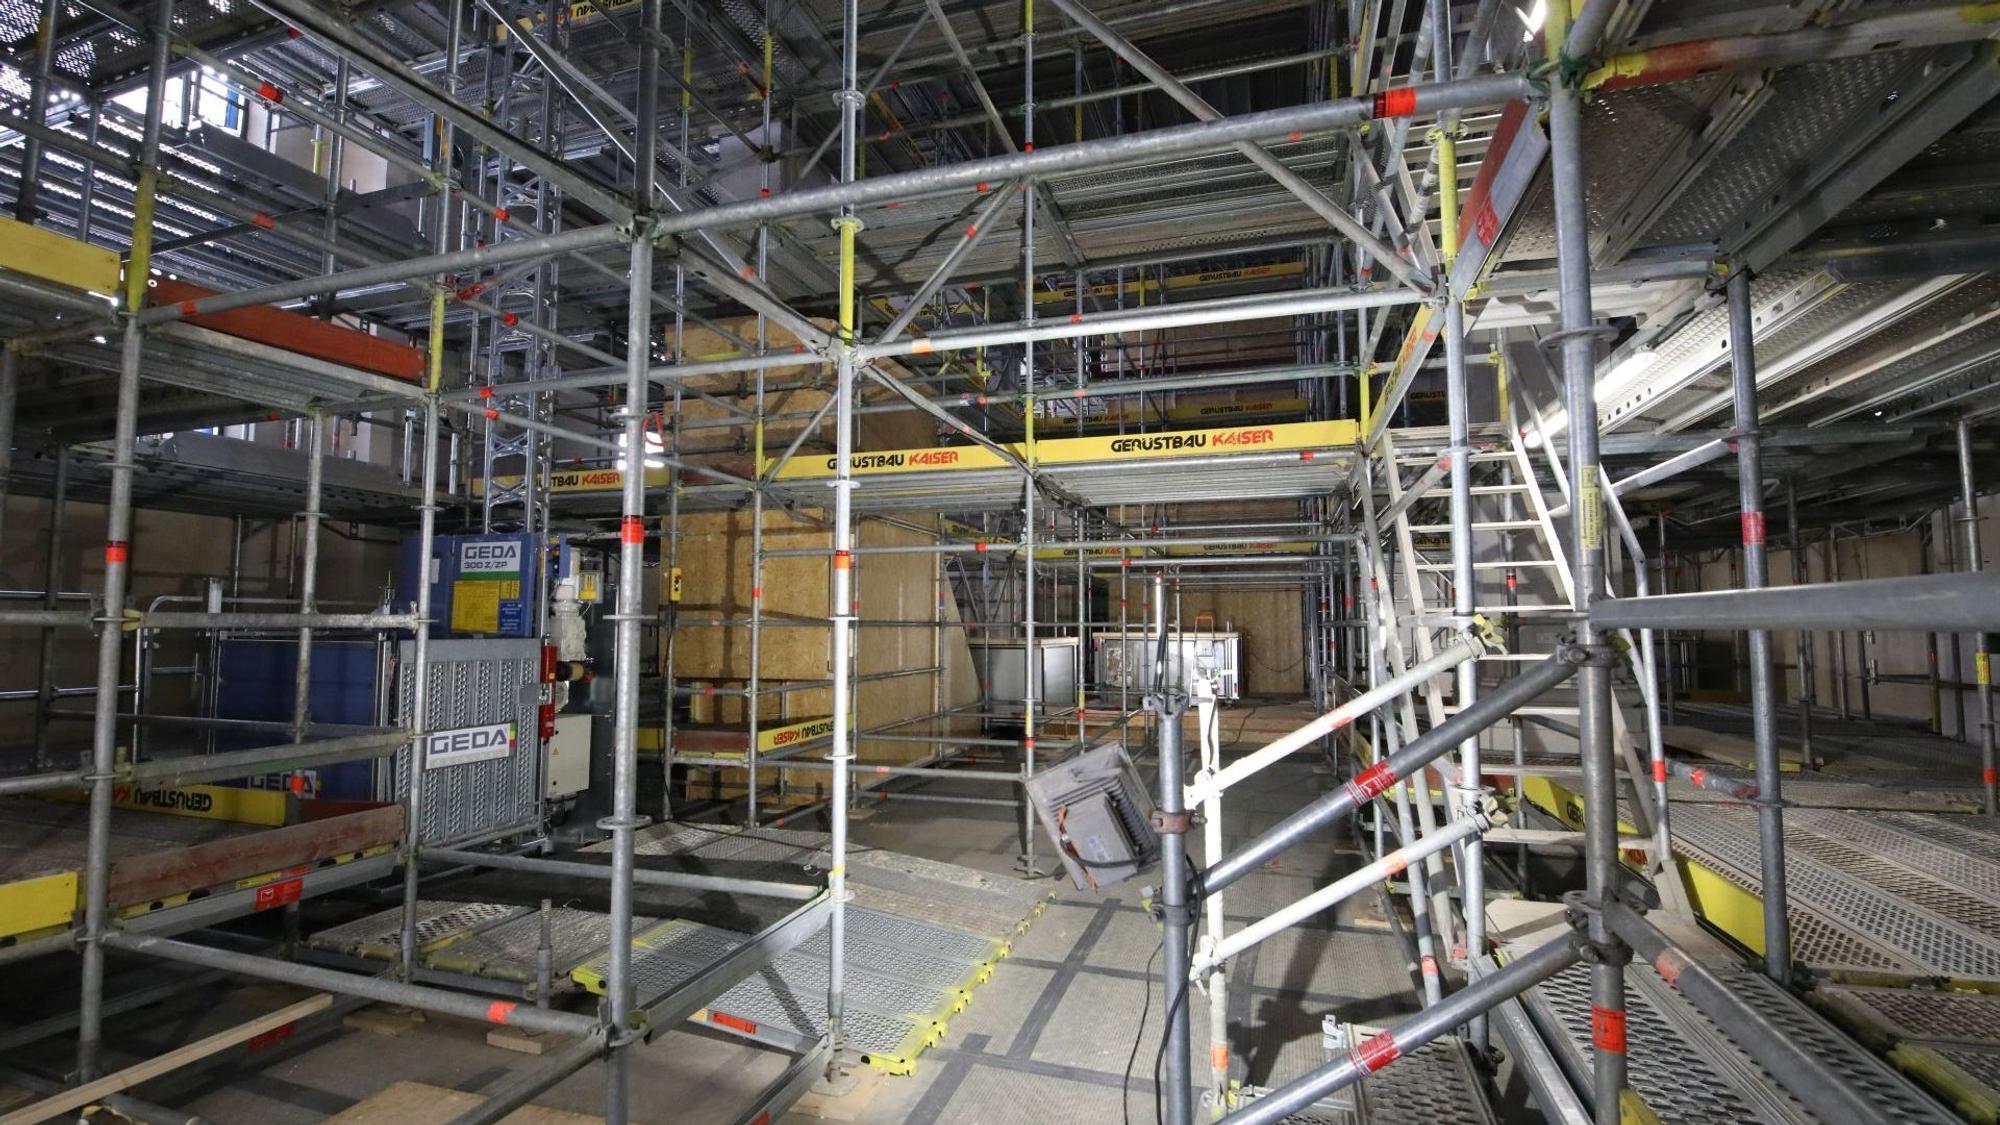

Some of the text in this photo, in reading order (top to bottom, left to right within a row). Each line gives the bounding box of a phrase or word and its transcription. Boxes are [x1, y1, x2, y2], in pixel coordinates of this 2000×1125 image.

[1212, 429, 1274, 447] KAISER
[909, 451, 958, 466] KAISER
[581, 472, 621, 485] KAISER
[464, 545, 516, 559] GEDA
[463, 561, 483, 569] 300
[430, 729, 507, 755] GEDA
